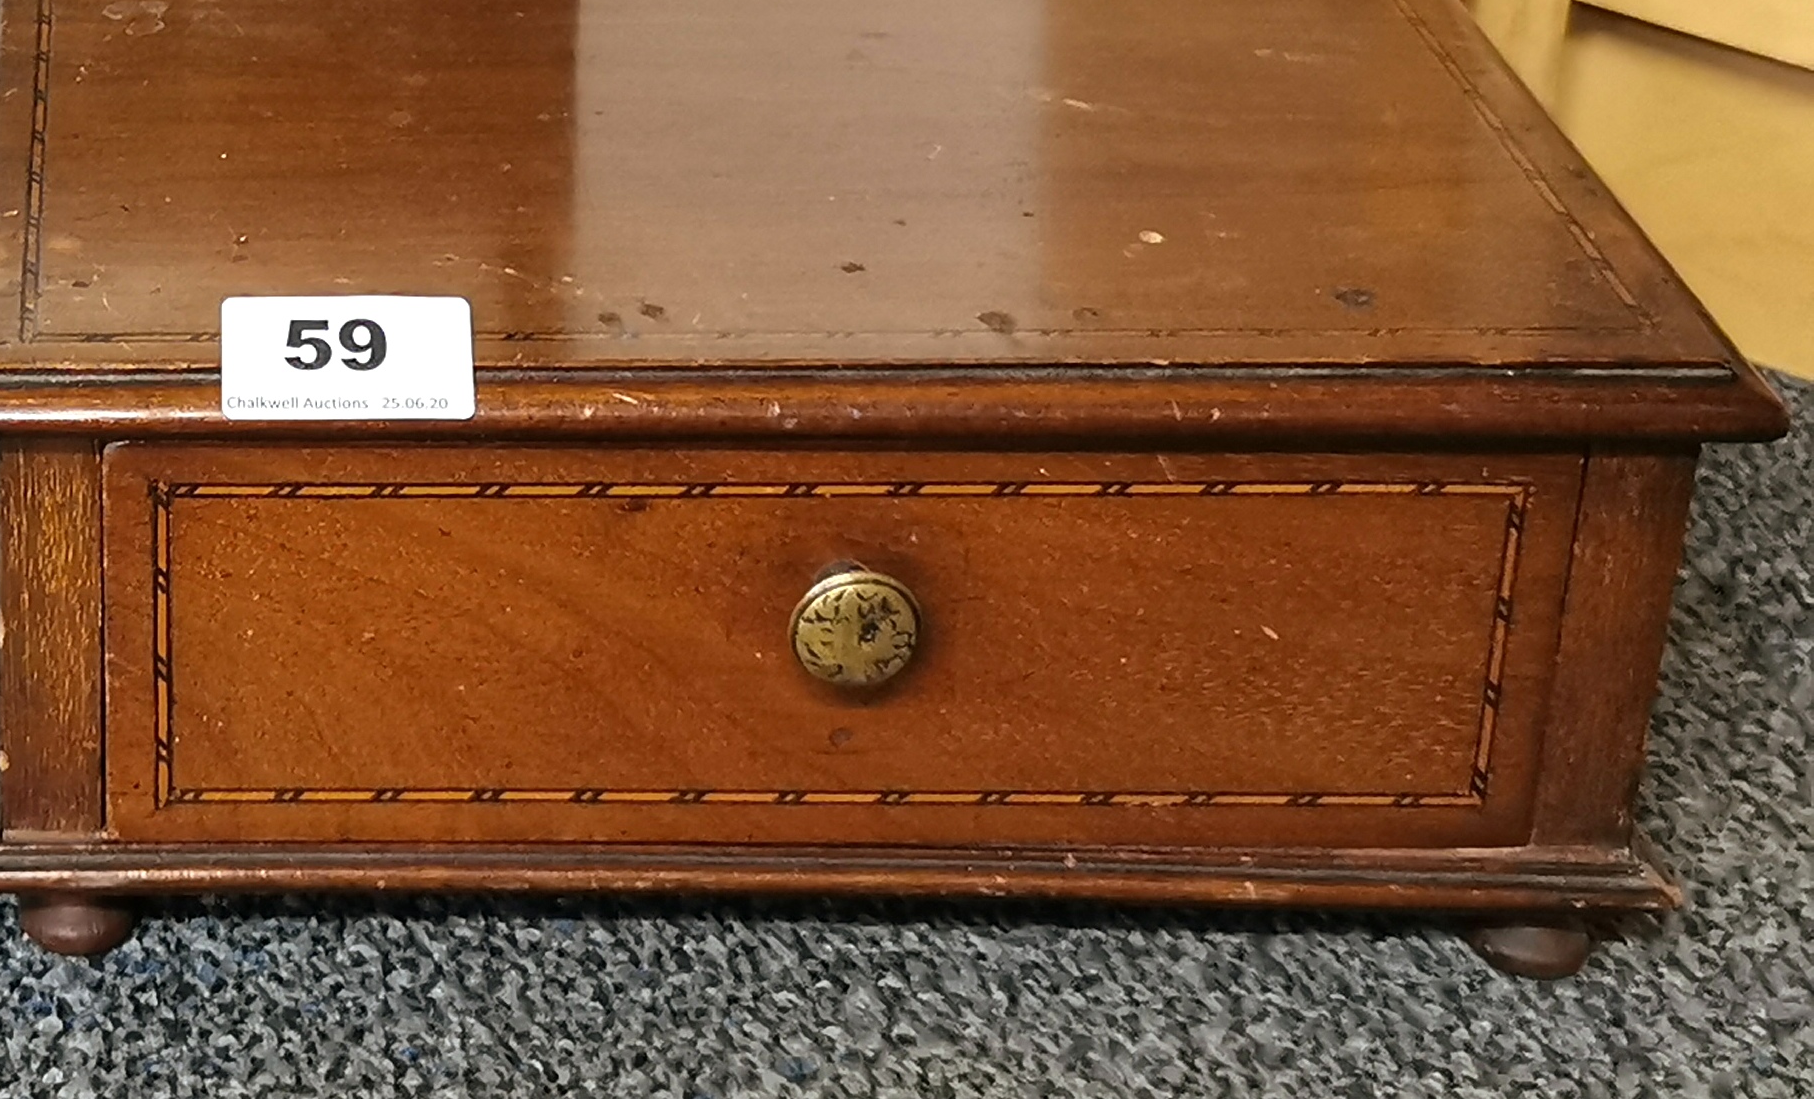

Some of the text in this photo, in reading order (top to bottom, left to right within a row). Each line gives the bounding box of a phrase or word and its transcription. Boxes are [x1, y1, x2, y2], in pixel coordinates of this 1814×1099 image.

[283, 318, 388, 372] 59
[226, 395, 449, 410] Chalkwell Auctions 25.06.20
